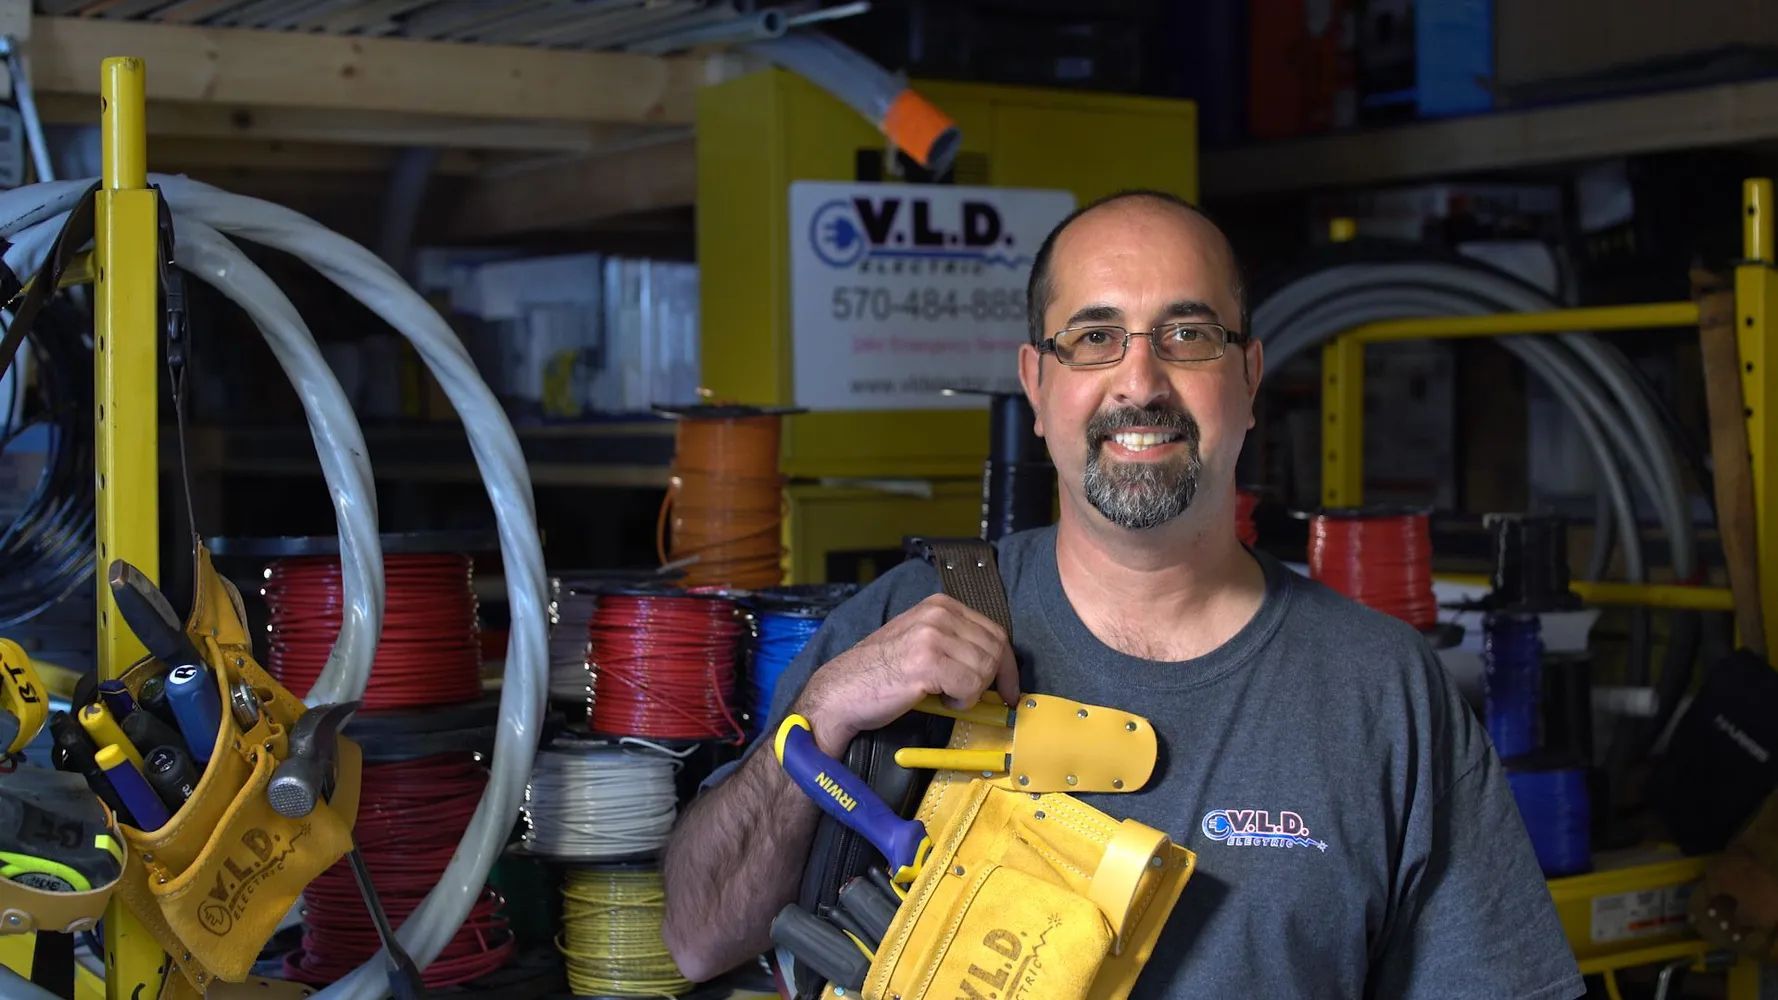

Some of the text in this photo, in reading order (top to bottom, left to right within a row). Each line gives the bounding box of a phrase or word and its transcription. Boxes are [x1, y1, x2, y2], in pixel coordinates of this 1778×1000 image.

[853, 198, 1015, 247] V.L.D.
[857, 260, 984, 275] ELECTRIC
[815, 772, 857, 812] IRWIN
[1225, 809, 1310, 837] V.L.D.
[1226, 837, 1294, 849] ELECTRIC
[208, 828, 281, 903] V.L.D.
[233, 861, 285, 921] ELECTRIC
